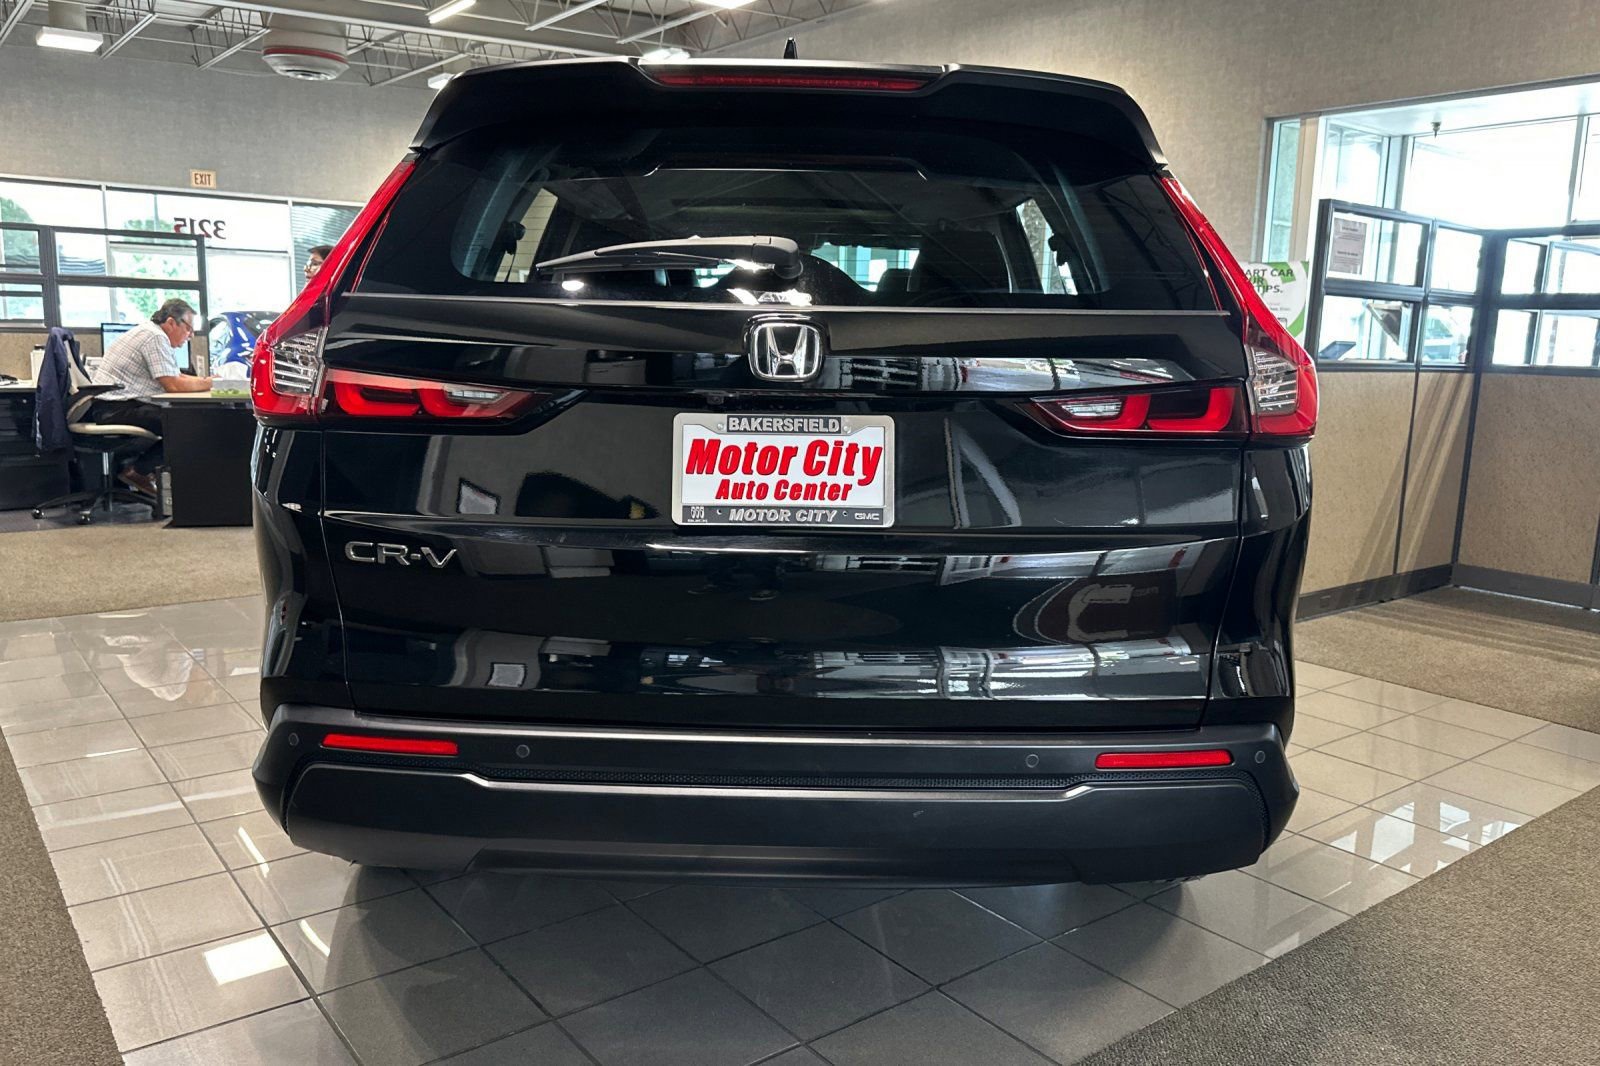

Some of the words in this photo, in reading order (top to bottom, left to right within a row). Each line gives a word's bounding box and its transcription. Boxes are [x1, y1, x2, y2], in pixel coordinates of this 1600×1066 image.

[194, 172, 211, 186] EXIT
[1270, 268, 1294, 277] CAR
[728, 416, 840, 433] BAKERSFIELD
[685, 438, 798, 476] Motor
[803, 439, 883, 487] City
[715, 478, 769, 500] Auto
[773, 479, 853, 501] Center
[728, 508, 791, 522] MOTOR
[795, 509, 838, 523] CITY
[854, 512, 880, 521] GMC
[344, 541, 458, 569] CR-V
